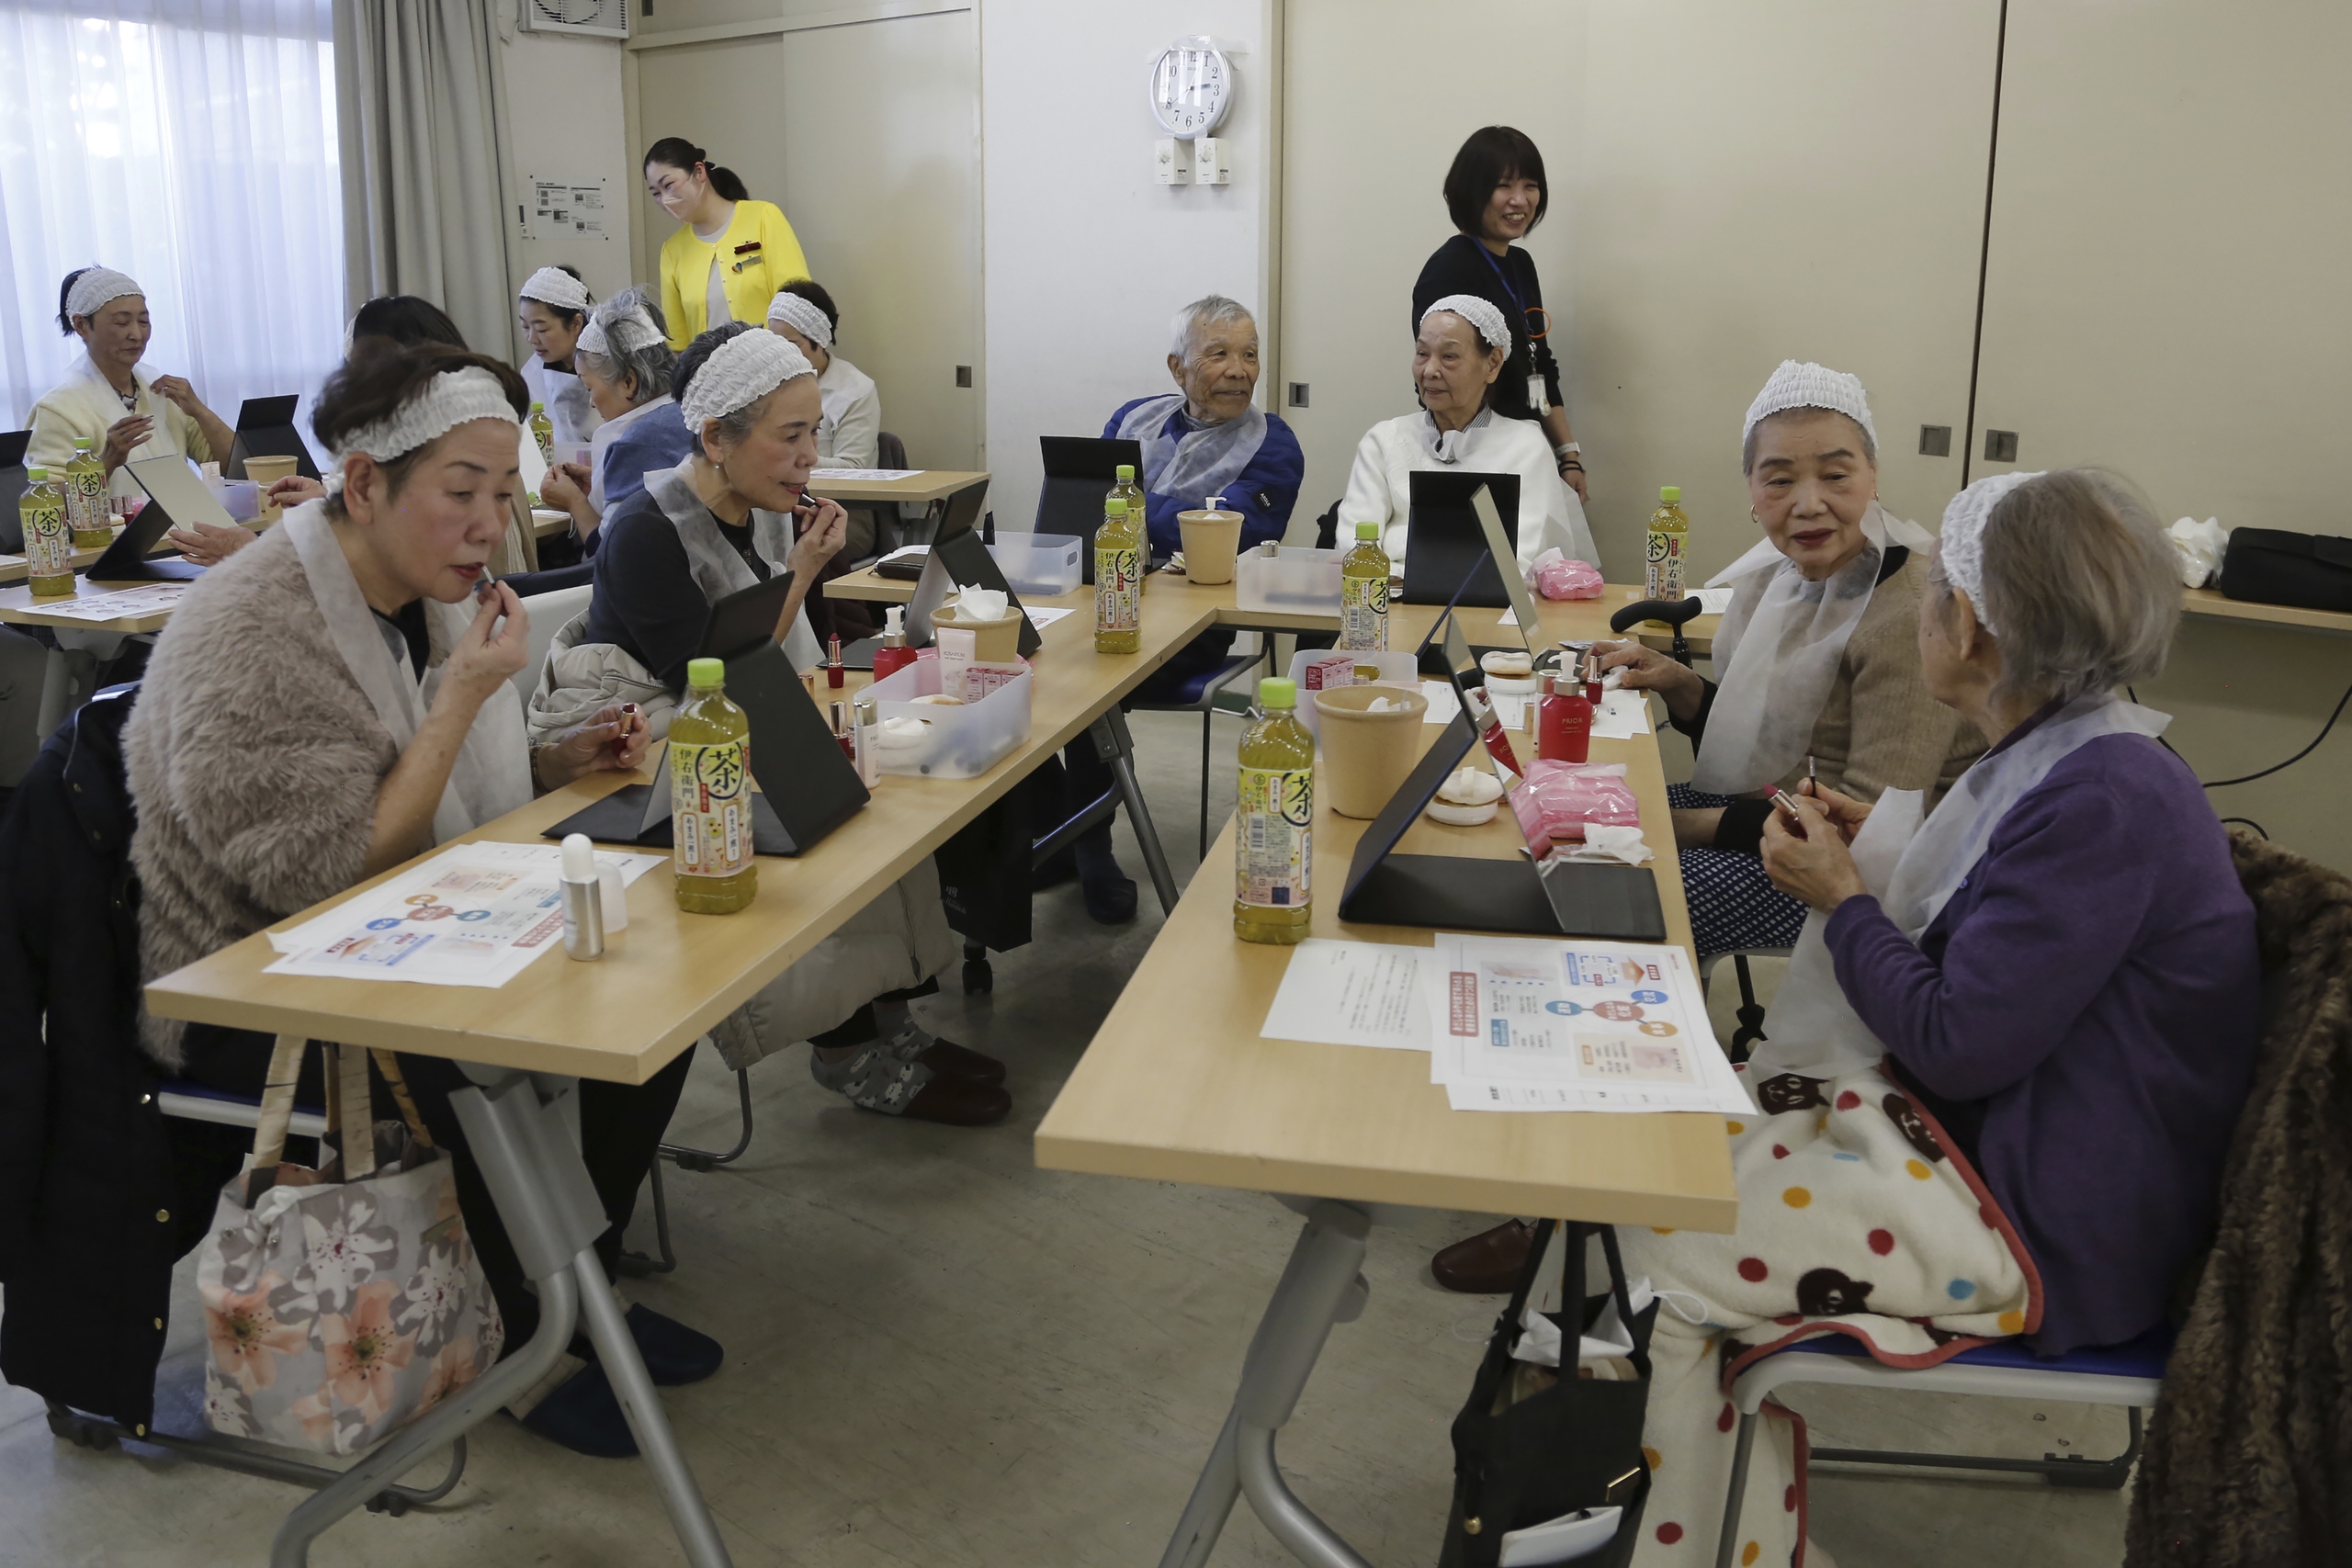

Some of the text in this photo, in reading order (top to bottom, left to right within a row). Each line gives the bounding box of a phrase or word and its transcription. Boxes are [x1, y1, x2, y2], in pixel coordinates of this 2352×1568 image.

[1169, 65, 1177, 77] 10
[1211, 67, 1218, 79] 2
[1213, 85, 1220, 96] 3
[1173, 110, 1181, 122] 7
[1208, 100, 1215, 113] 4
[1185, 115, 1193, 128] 6
[1198, 112, 1204, 124] 5
[81, 474, 97, 493] 茶
[39, 510, 58, 532] 茶
[1647, 534, 1664, 558] 茶
[1105, 552, 1114, 583] 伊右衛門
[1123, 551, 1137, 578] 茶
[1667, 558, 1679, 600] 伊右衛門
[1373, 579, 1389, 609] 茶
[706, 748, 739, 791] 茶
[1288, 773, 1313, 817] 茶
